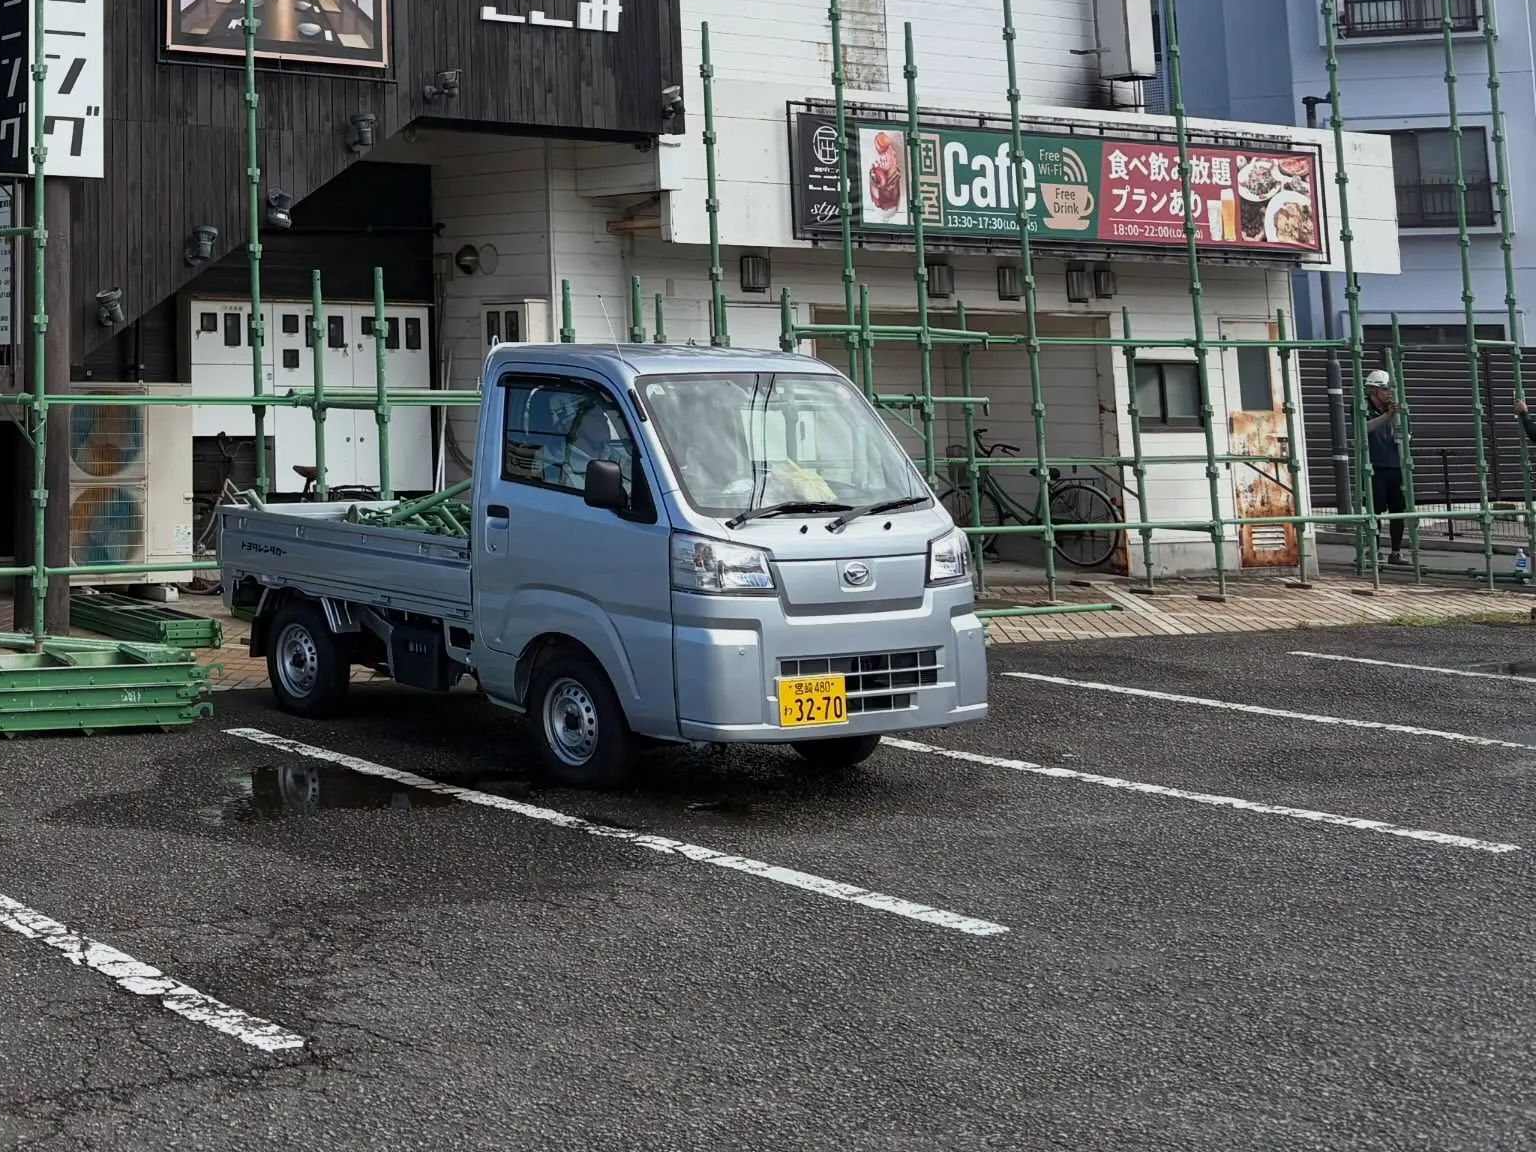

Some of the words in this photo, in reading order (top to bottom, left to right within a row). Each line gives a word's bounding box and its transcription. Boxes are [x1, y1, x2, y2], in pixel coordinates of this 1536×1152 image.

[1039, 149, 1060, 162] Free
[944, 141, 1037, 211] Cafe
[1038, 163, 1062, 177] Wi-Fi
[1055, 187, 1076, 201] Free
[1053, 201, 1079, 215] Drink
[1112, 185, 1202, 218] プランあり
[814, 680, 831, 693] 480
[784, 706, 793, 716] わ
